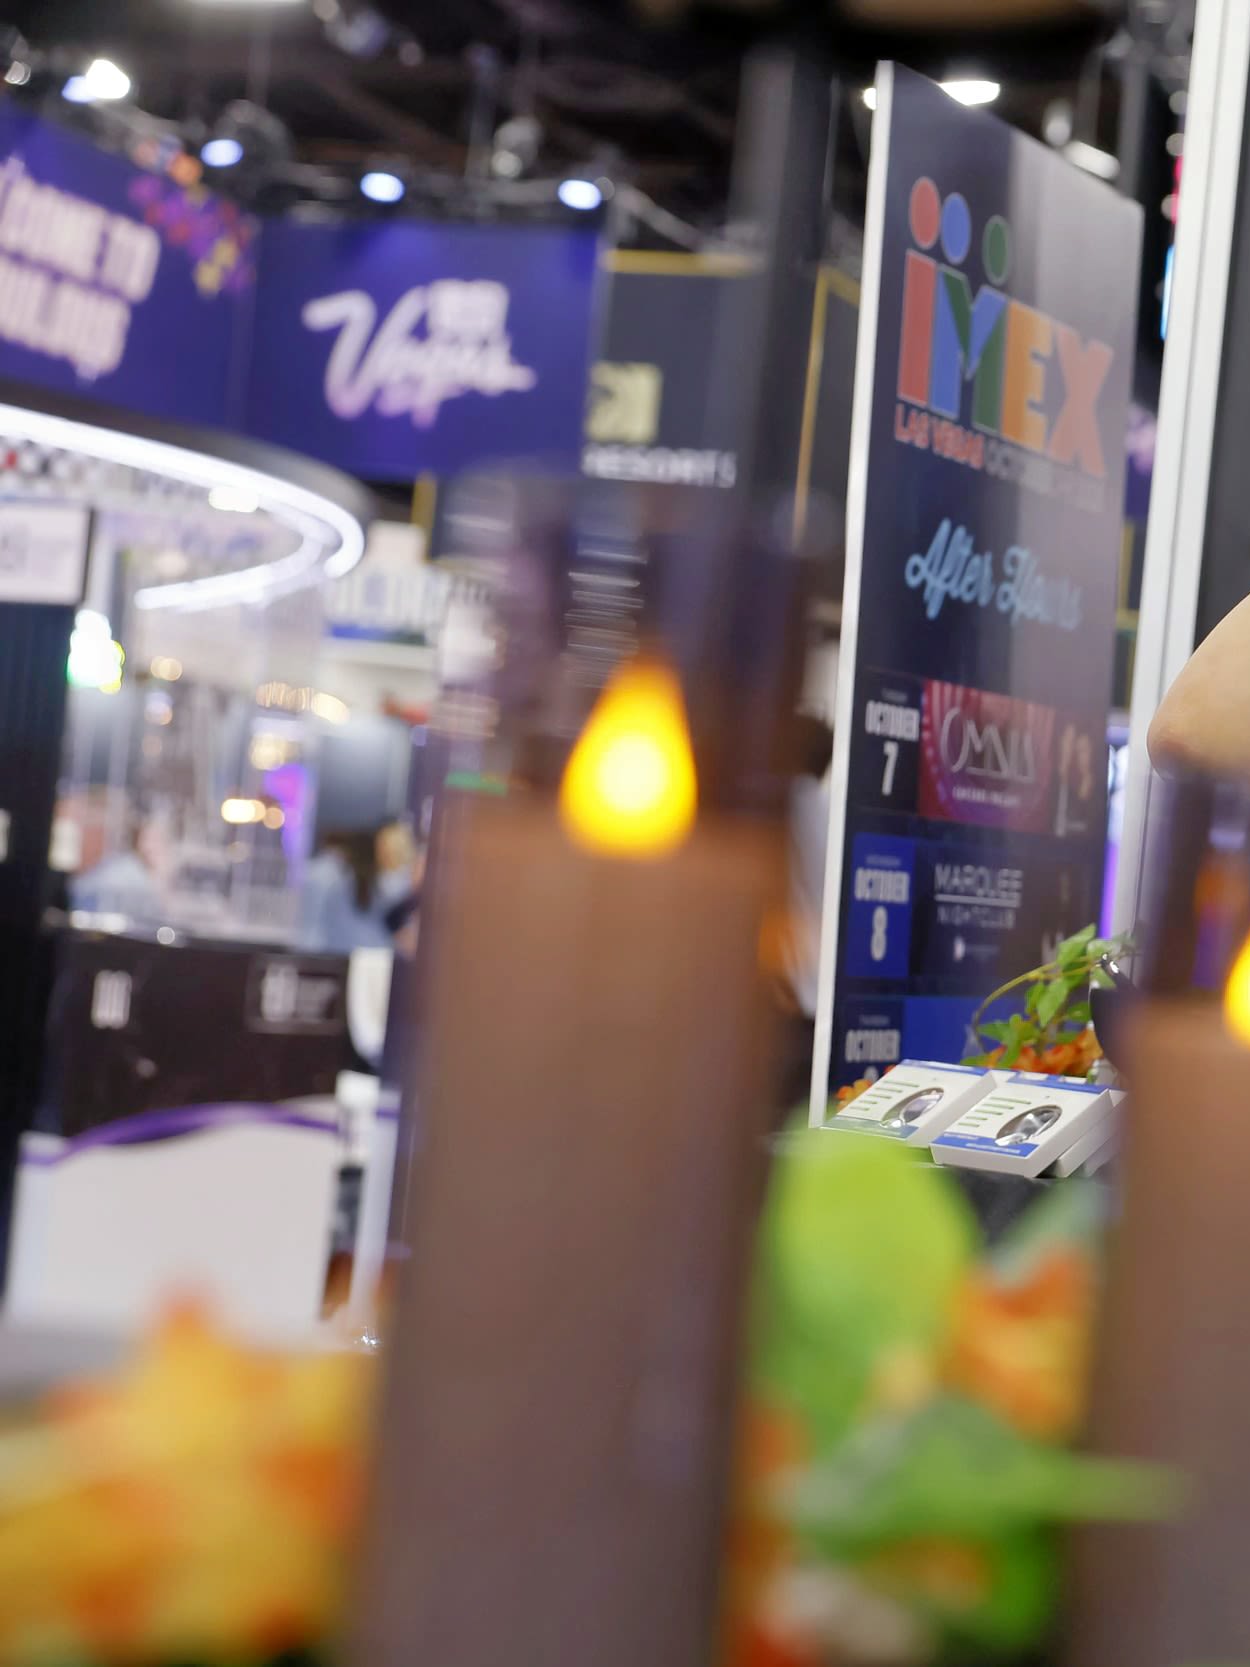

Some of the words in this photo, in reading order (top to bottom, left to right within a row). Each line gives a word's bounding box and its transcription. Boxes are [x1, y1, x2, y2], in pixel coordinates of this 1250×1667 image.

[904, 517, 993, 621] After
[865, 699, 920, 741] OCTOBER
[882, 741, 899, 796] 7
[934, 863, 1024, 900] MARQUEE
[870, 905, 888, 961] 8
